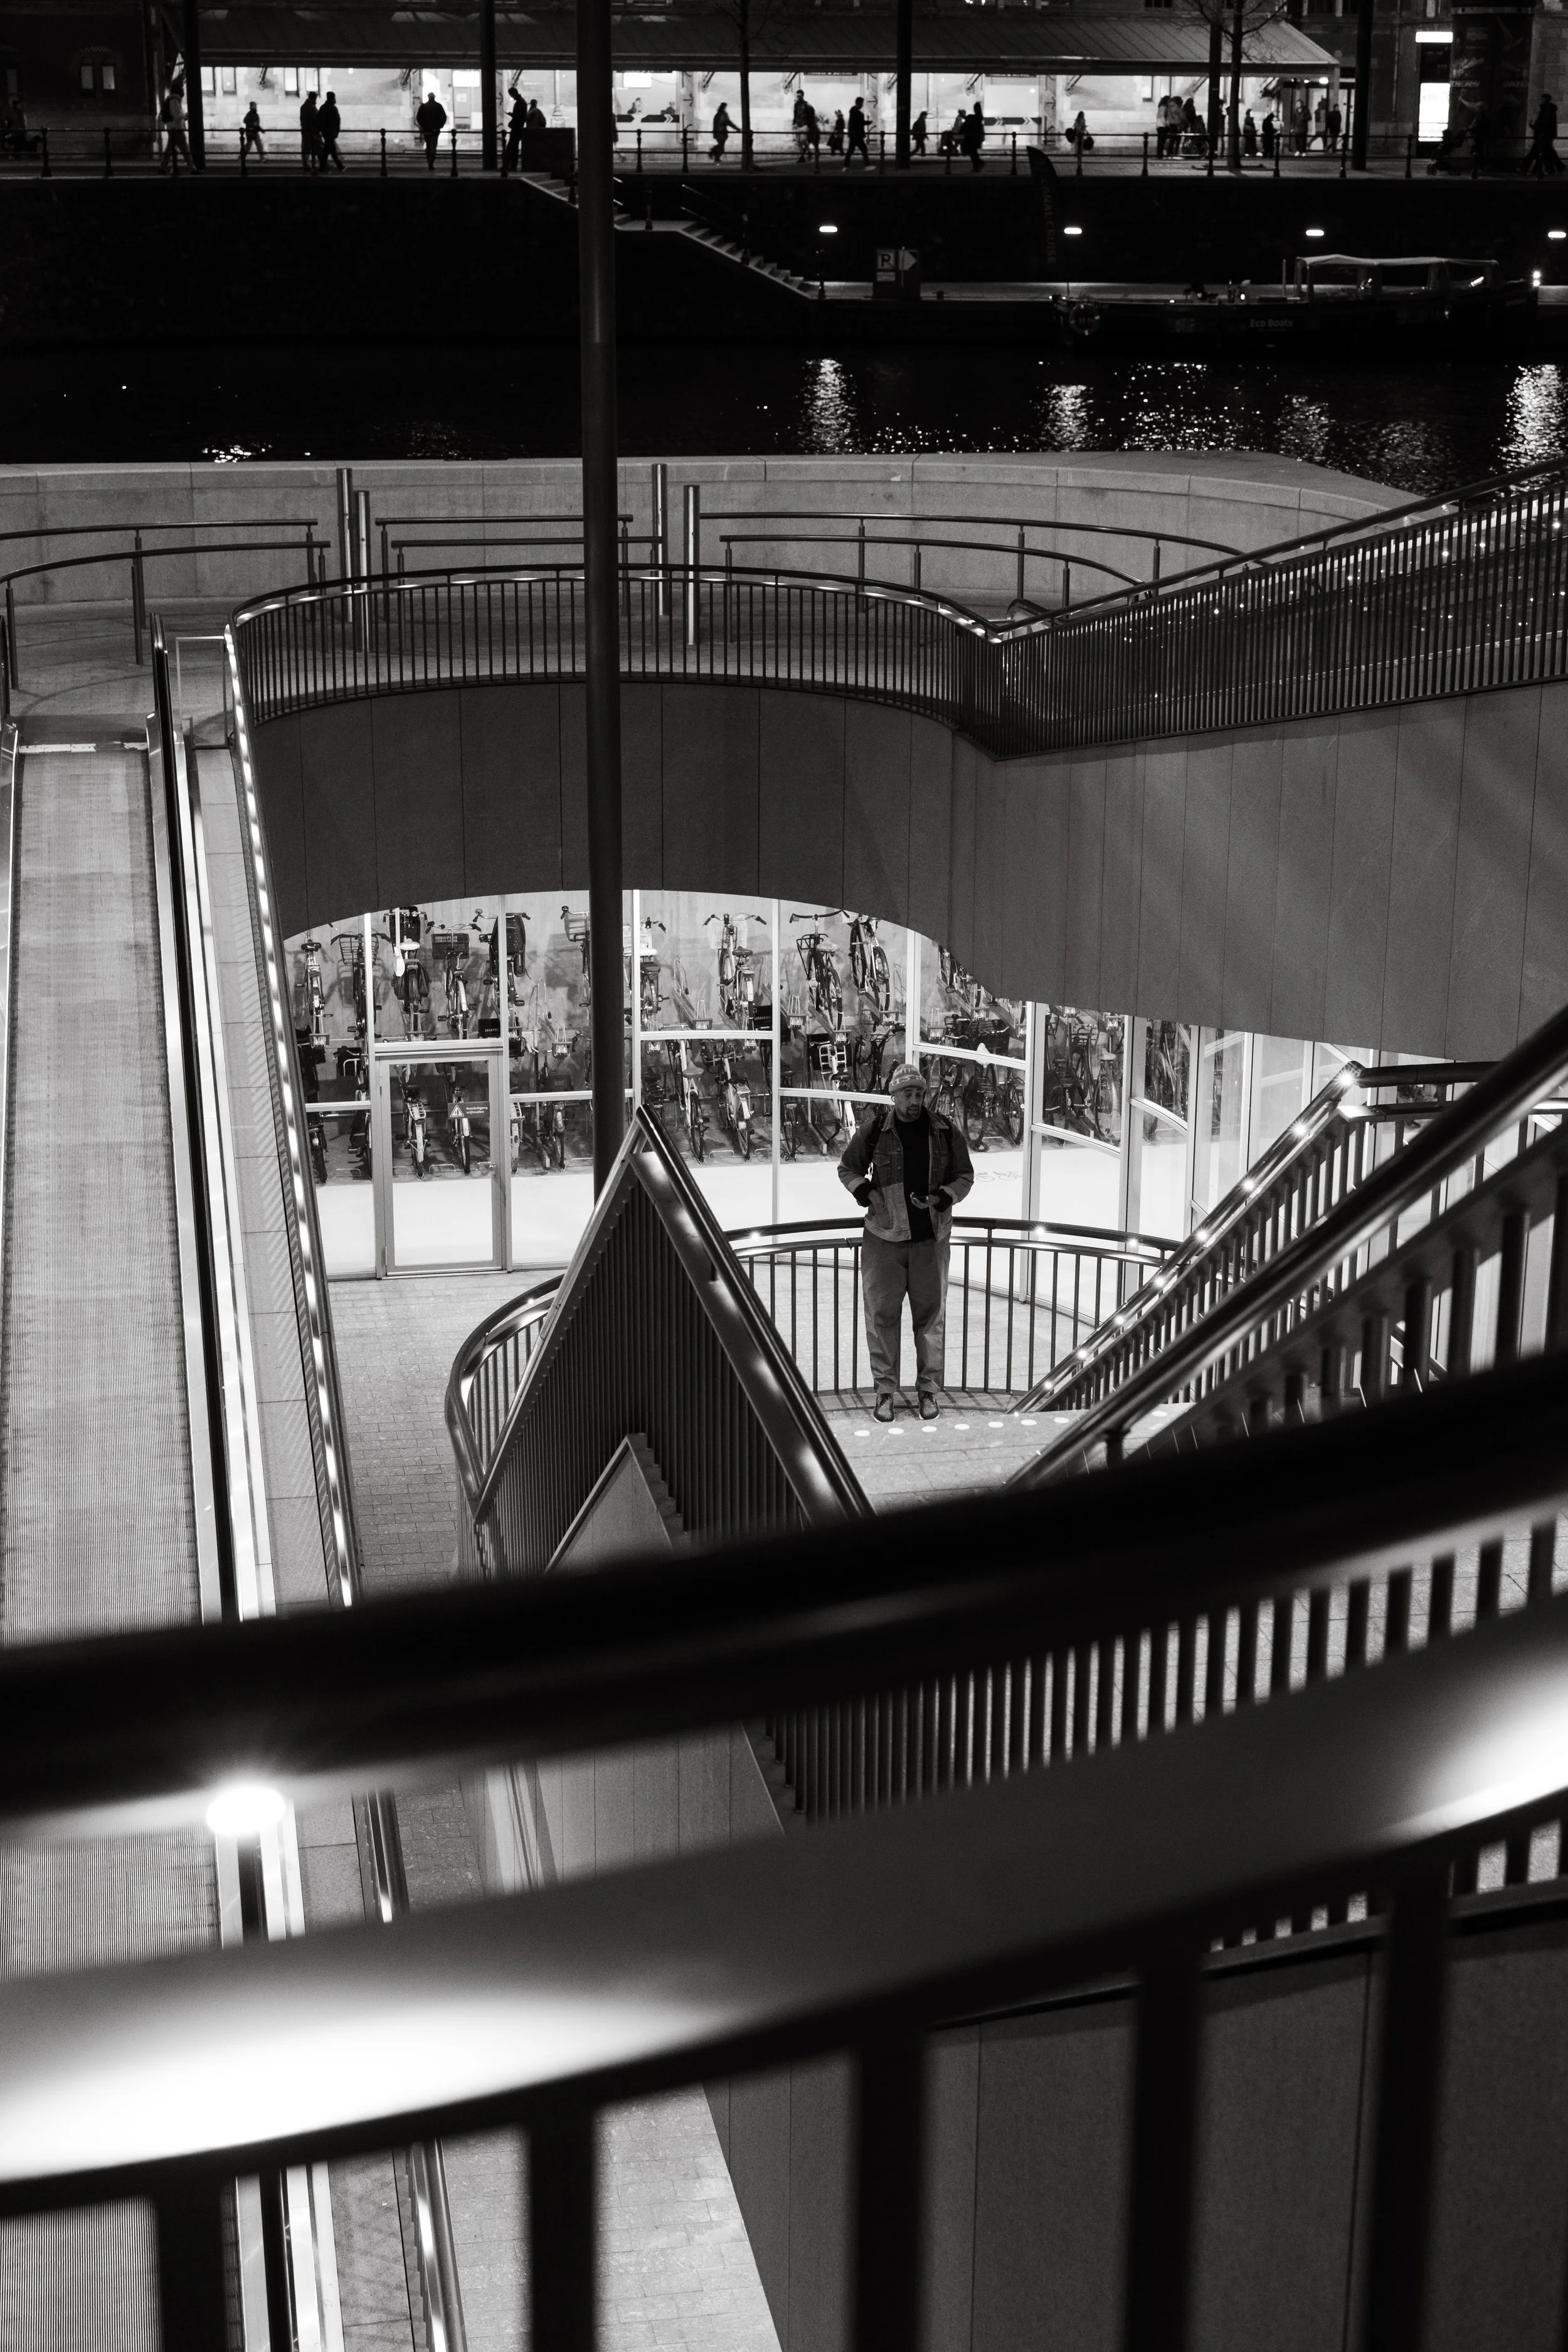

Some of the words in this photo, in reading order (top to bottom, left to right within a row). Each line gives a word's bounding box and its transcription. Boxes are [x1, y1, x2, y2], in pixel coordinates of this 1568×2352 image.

[1041, 178, 1053, 218] CANAL
[1044, 220, 1057, 263] CRUISE
[881, 253, 891, 267] P
[1250, 319, 1266, 327] Eco
[1268, 319, 1293, 327] Boats
